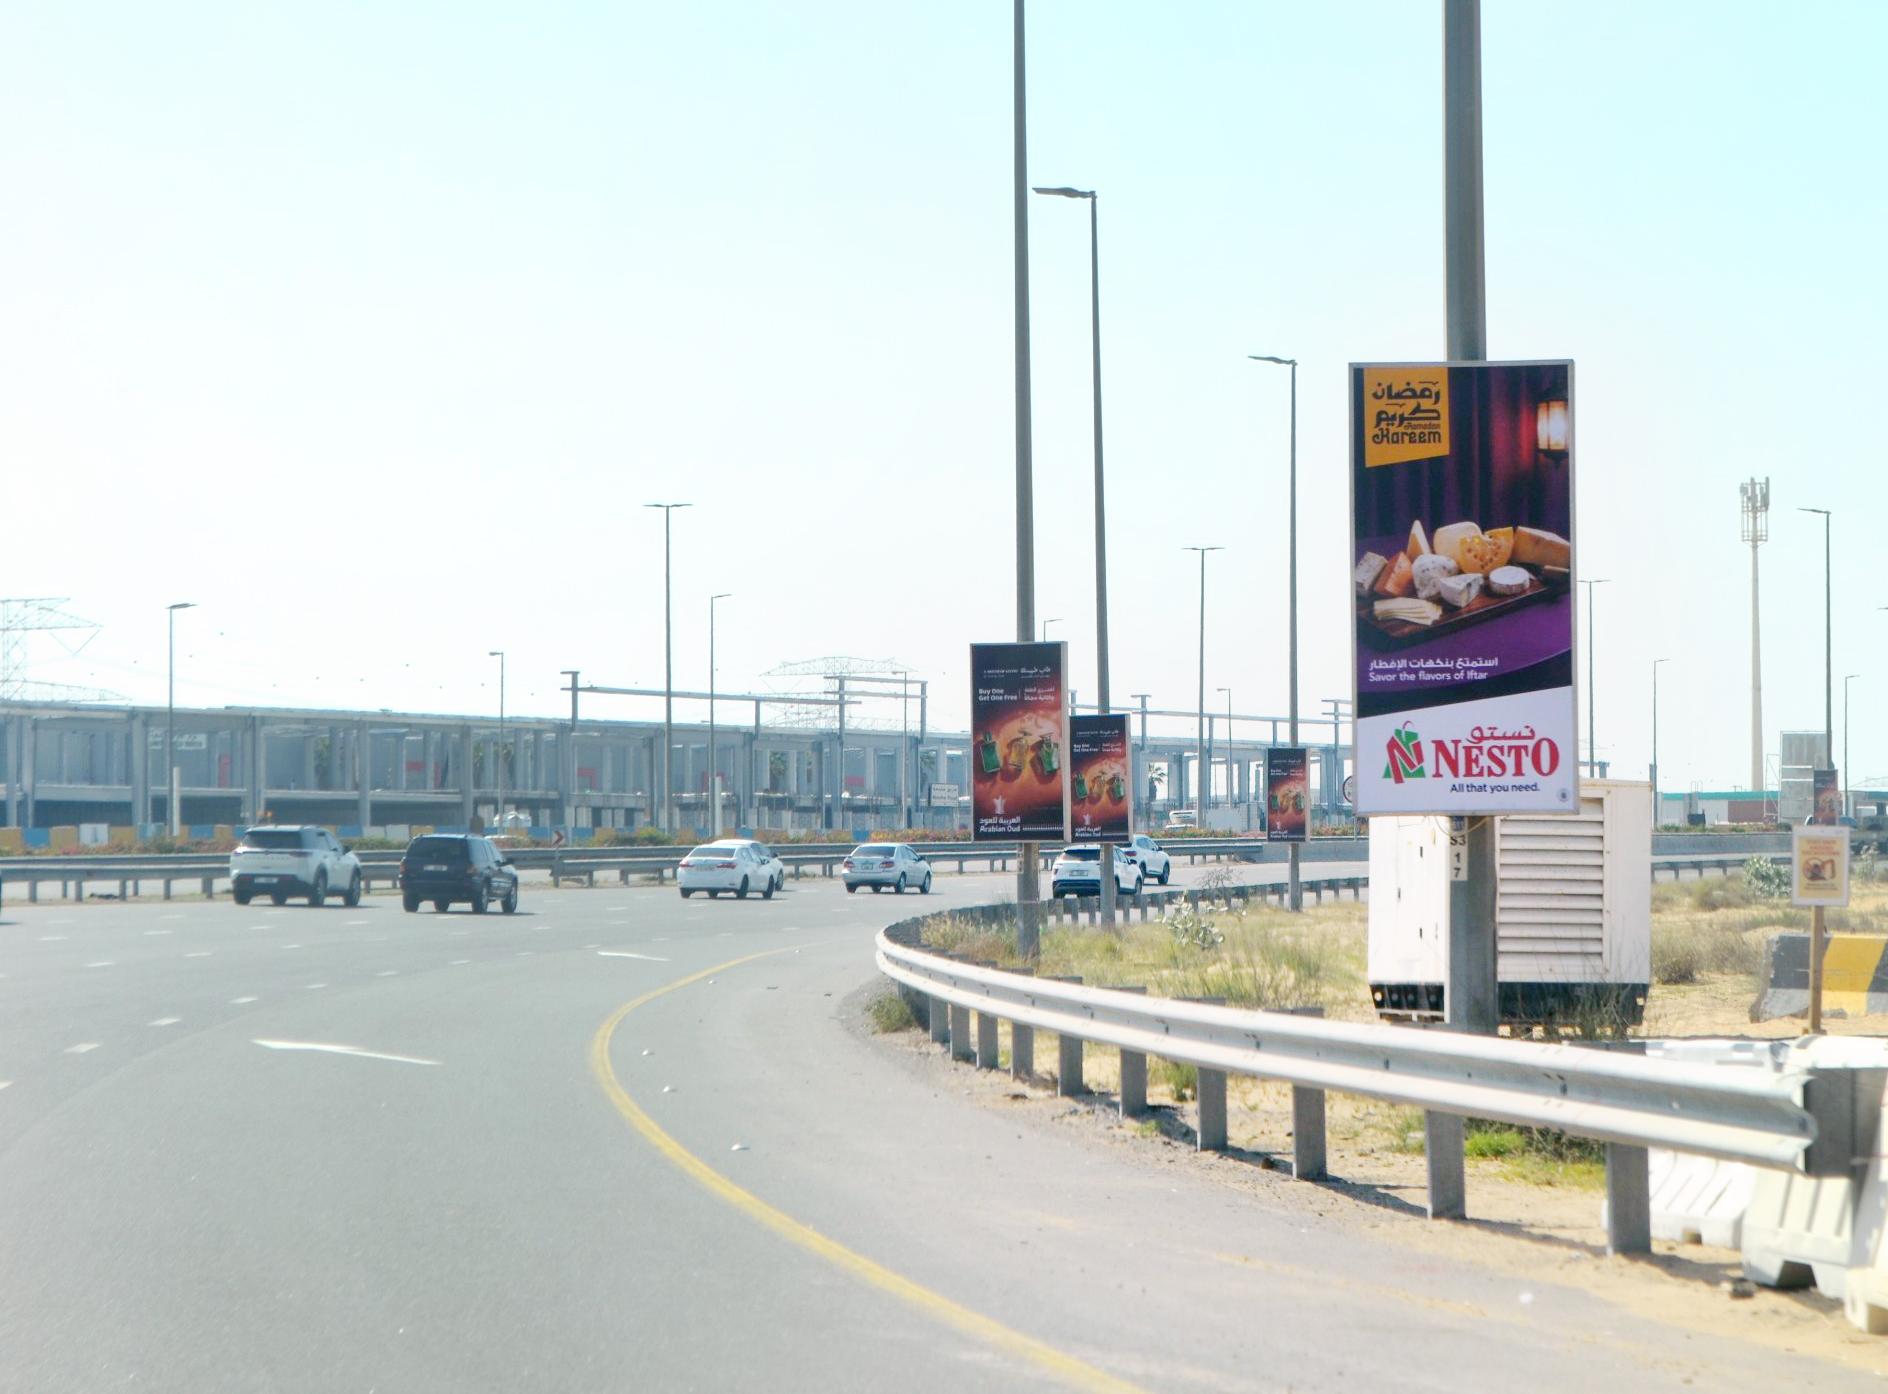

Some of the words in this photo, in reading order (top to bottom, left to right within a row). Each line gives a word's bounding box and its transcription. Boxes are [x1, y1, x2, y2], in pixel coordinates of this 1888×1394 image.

[1371, 381, 1440, 405] رمضان
[1374, 400, 1440, 428] كريم
[1372, 427, 1442, 444] Kareem
[1409, 658, 1454, 669] بنكهات
[1456, 657, 1498, 669] استمتع
[1369, 672, 1396, 681] Savor
[1400, 671, 1416, 680] the
[1419, 671, 1451, 680] flavors
[1454, 670, 1464, 680] of
[1466, 670, 1488, 680] Iftar
[978, 688, 990, 696] Buy
[1465, 725, 1536, 744] نستو
[1431, 737, 1560, 778] NESTO
[1450, 783, 1464, 792] All
[1466, 783, 1487, 792] that
[1489, 785, 1509, 794] you
[1511, 782, 1540, 792] need.
[979, 825, 1006, 833] Arabian
[1007, 825, 1021, 833] Oud
[1450, 835, 1466, 846] S3
[1455, 852, 1461, 863] 1
[1454, 867, 1461, 878] 7
